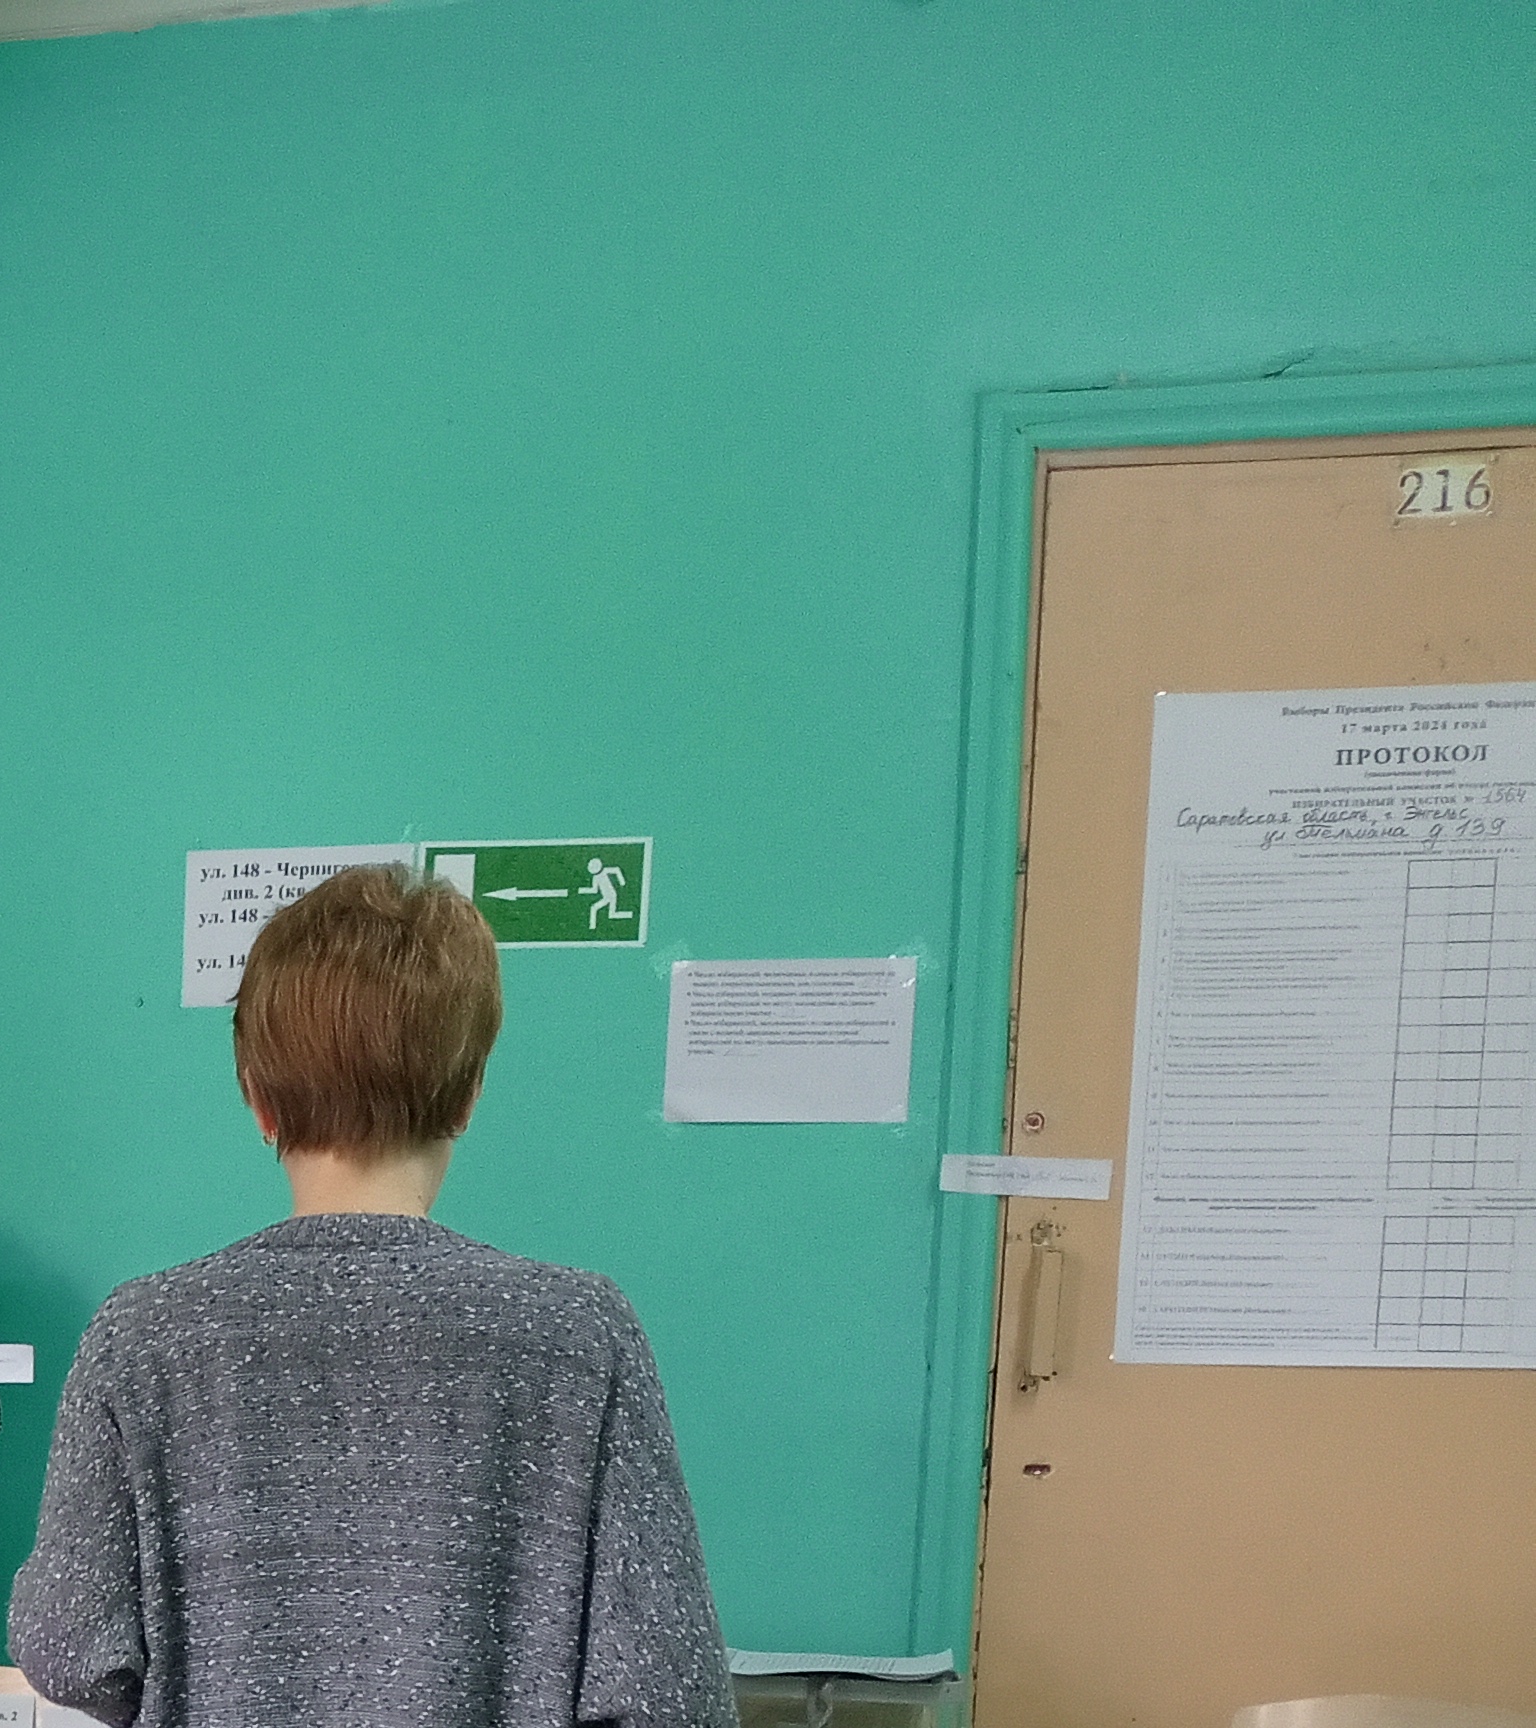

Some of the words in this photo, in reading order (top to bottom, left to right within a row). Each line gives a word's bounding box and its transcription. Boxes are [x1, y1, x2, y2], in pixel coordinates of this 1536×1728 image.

[1397, 467, 1492, 516] 216
[1334, 744, 1490, 767] ПРОТОКОЛ
[200, 868, 226, 882] ул.
[232, 864, 260, 878] 148
[222, 887, 259, 901] див.
[264, 886, 273, 899] 2
[198, 913, 224, 928] ул.
[230, 909, 258, 923] 148
[197, 958, 222, 973] ул.
[11, 1711, 18, 1721] 2
